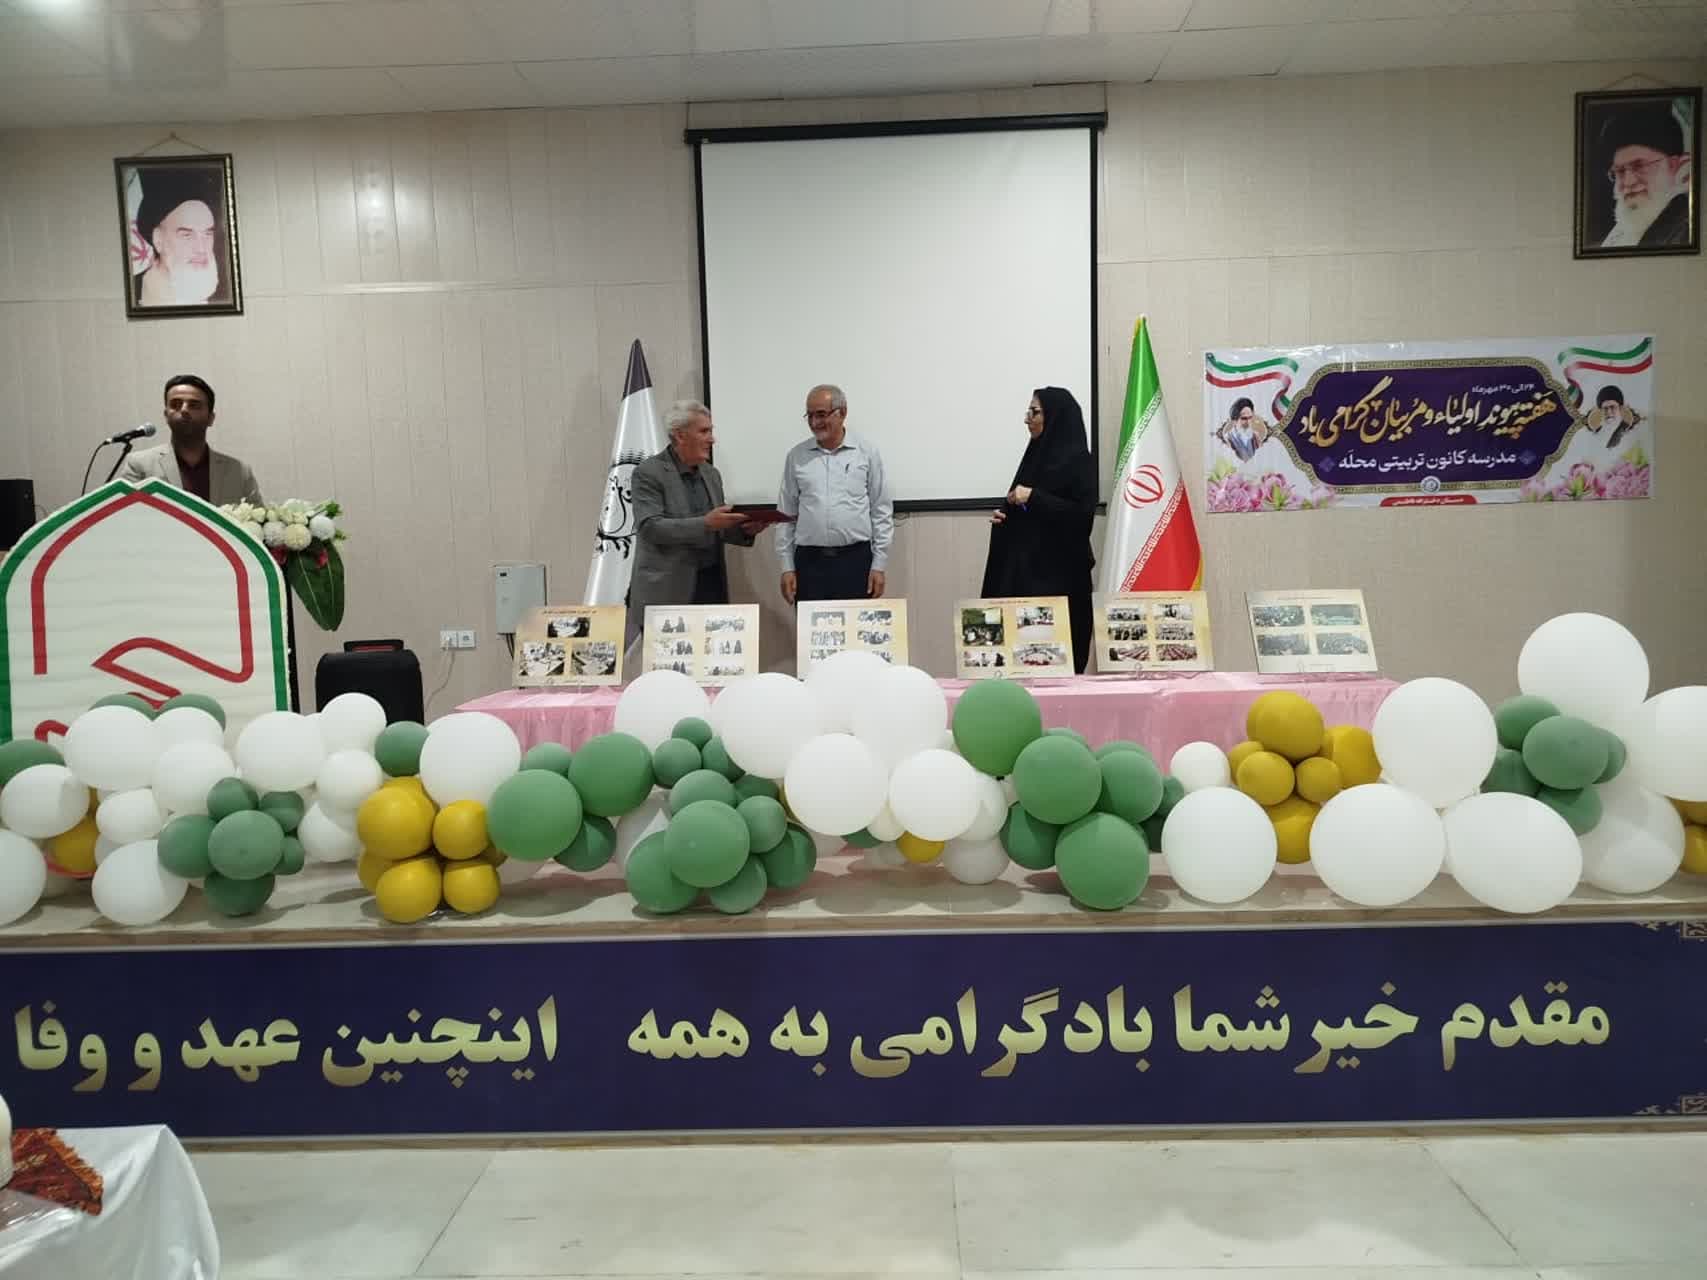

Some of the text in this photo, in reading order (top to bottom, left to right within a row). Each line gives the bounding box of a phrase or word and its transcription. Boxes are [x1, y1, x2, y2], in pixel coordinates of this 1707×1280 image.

[1299, 404, 1320, 443] باد
[1316, 375, 1394, 447] گرامی
[1378, 453, 1426, 472] تربیتی
[1425, 449, 1468, 470] کانون
[1467, 451, 1517, 468] مدرسه
[14, 1001, 109, 1091] وفا
[180, 1018, 301, 1082] عهد
[322, 995, 558, 1089] اینچنین
[627, 1007, 750, 1060] همه
[769, 1006, 830, 1076] به
[1173, 984, 1291, 1053] شما
[1293, 981, 1420, 1074] خیر
[1440, 982, 1610, 1071] مقدم
[128, 1032, 163, 1091] و
